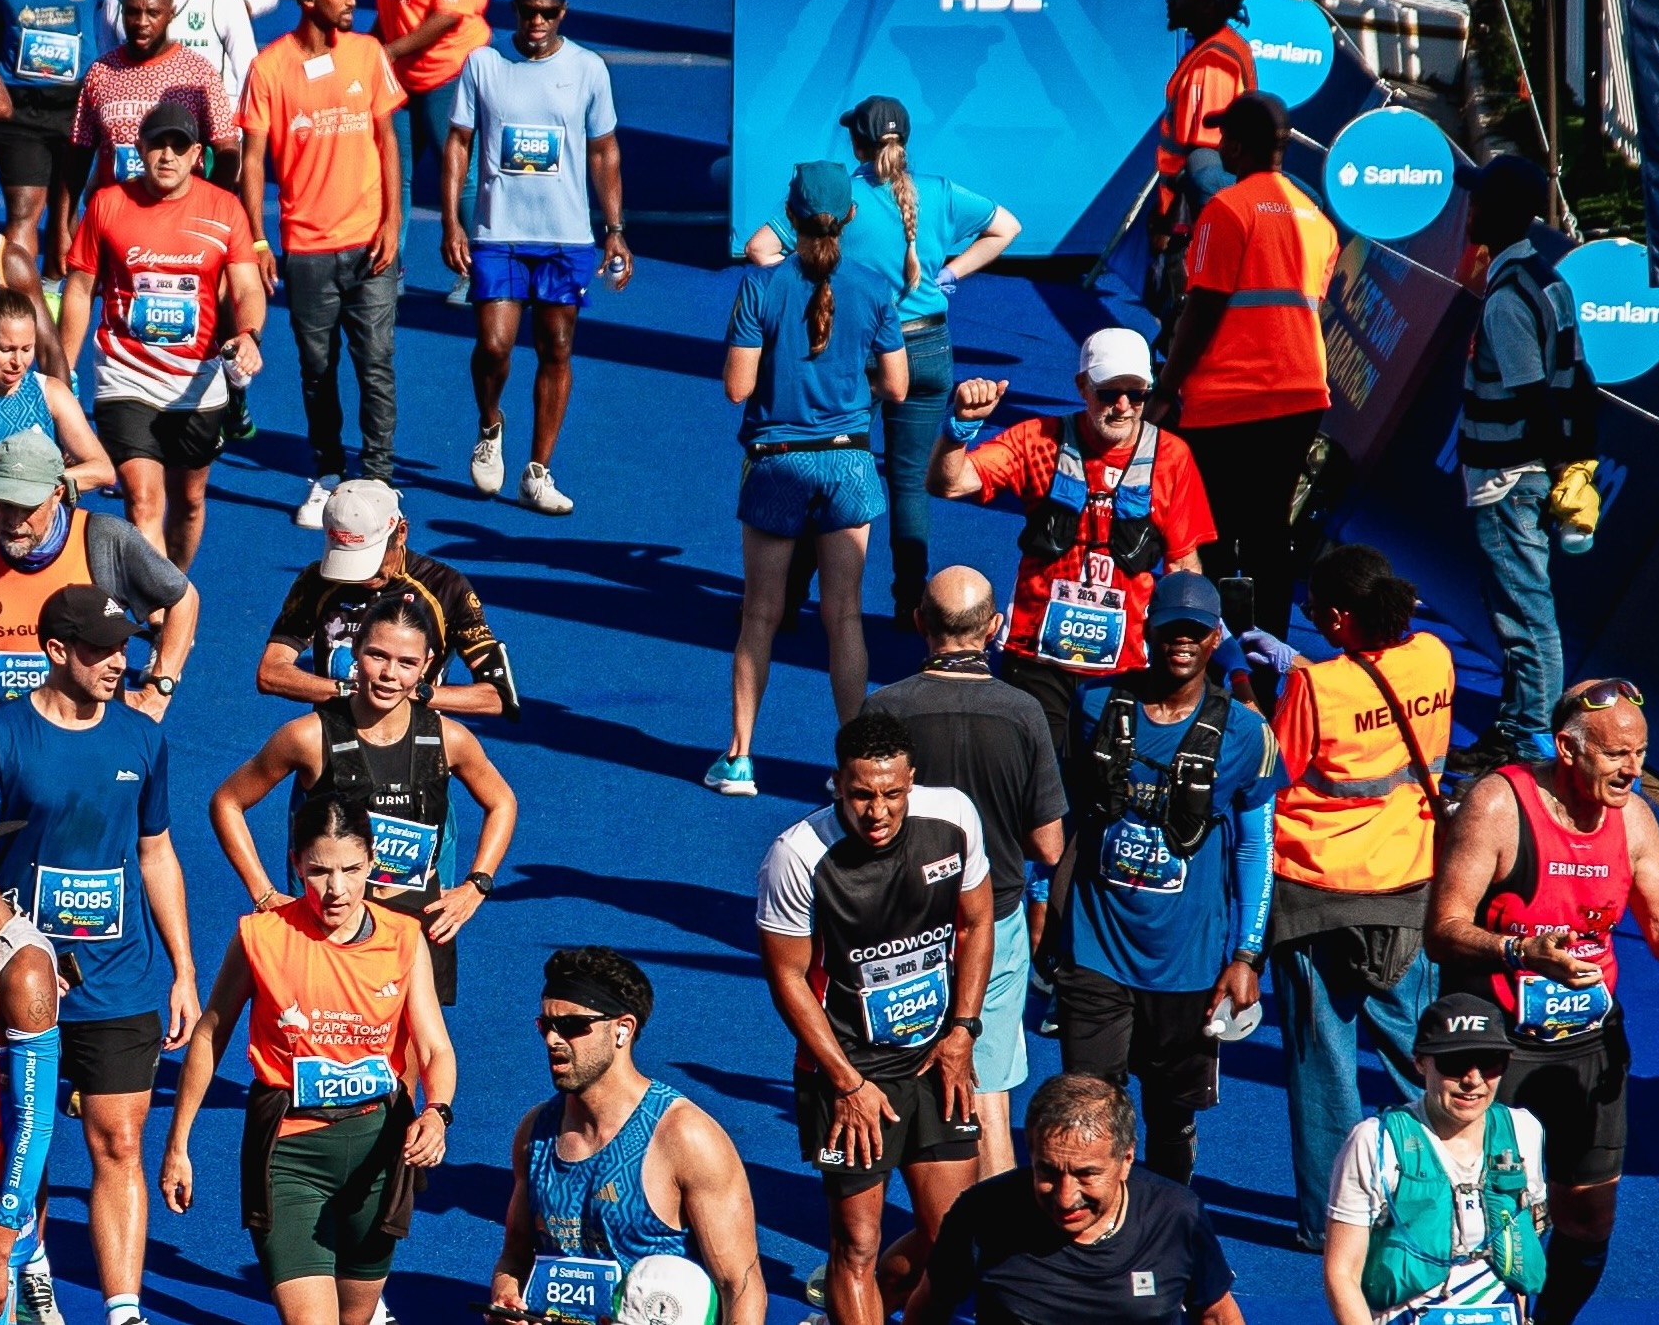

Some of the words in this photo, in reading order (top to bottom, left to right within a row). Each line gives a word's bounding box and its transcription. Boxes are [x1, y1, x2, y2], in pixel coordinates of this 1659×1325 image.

[29, 42, 70, 60] 24872
[1249, 40, 1322, 65] Sanlam
[512, 138, 550, 154] 7986
[1363, 163, 1442, 187] Sanlam
[126, 246, 205, 266] Edgemead
[145, 308, 185, 325] 10113
[1089, 557, 1111, 583] 60
[1076, 611, 1108, 624] Sanlam
[1060, 620, 1107, 642] 9035
[15, 659, 47, 669] Sanlam
[1354, 689, 1453, 734] MEICAL
[386, 825, 421, 840] Sanlam
[1113, 838, 1171, 865] 13256
[1548, 861, 1609, 879] ERNESTO
[73, 877, 108, 889] Sanlam
[53, 890, 113, 910] 16095
[850, 924, 953, 963] GOODWOOD
[895, 959, 918, 977] 2026
[898, 980, 931, 999] Sanlam
[884, 993, 938, 1022] 12844
[1545, 993, 1591, 1015] 6412
[323, 1010, 363, 1022] Sanlam
[1447, 1015, 1489, 1033] VYE
[312, 1022, 348, 1034] CAPE
[352, 1023, 392, 1035] TOWN
[311, 1033, 388, 1046] MARATHON
[24, 1049, 37, 1092] ARICAN
[315, 1077, 377, 1098] 12100
[16, 1094, 35, 1155] CHAMIONS
[9, 1155, 25, 1189] UNITE
[558, 1266, 595, 1281] Sanlam
[546, 1283, 596, 1305] 8241
